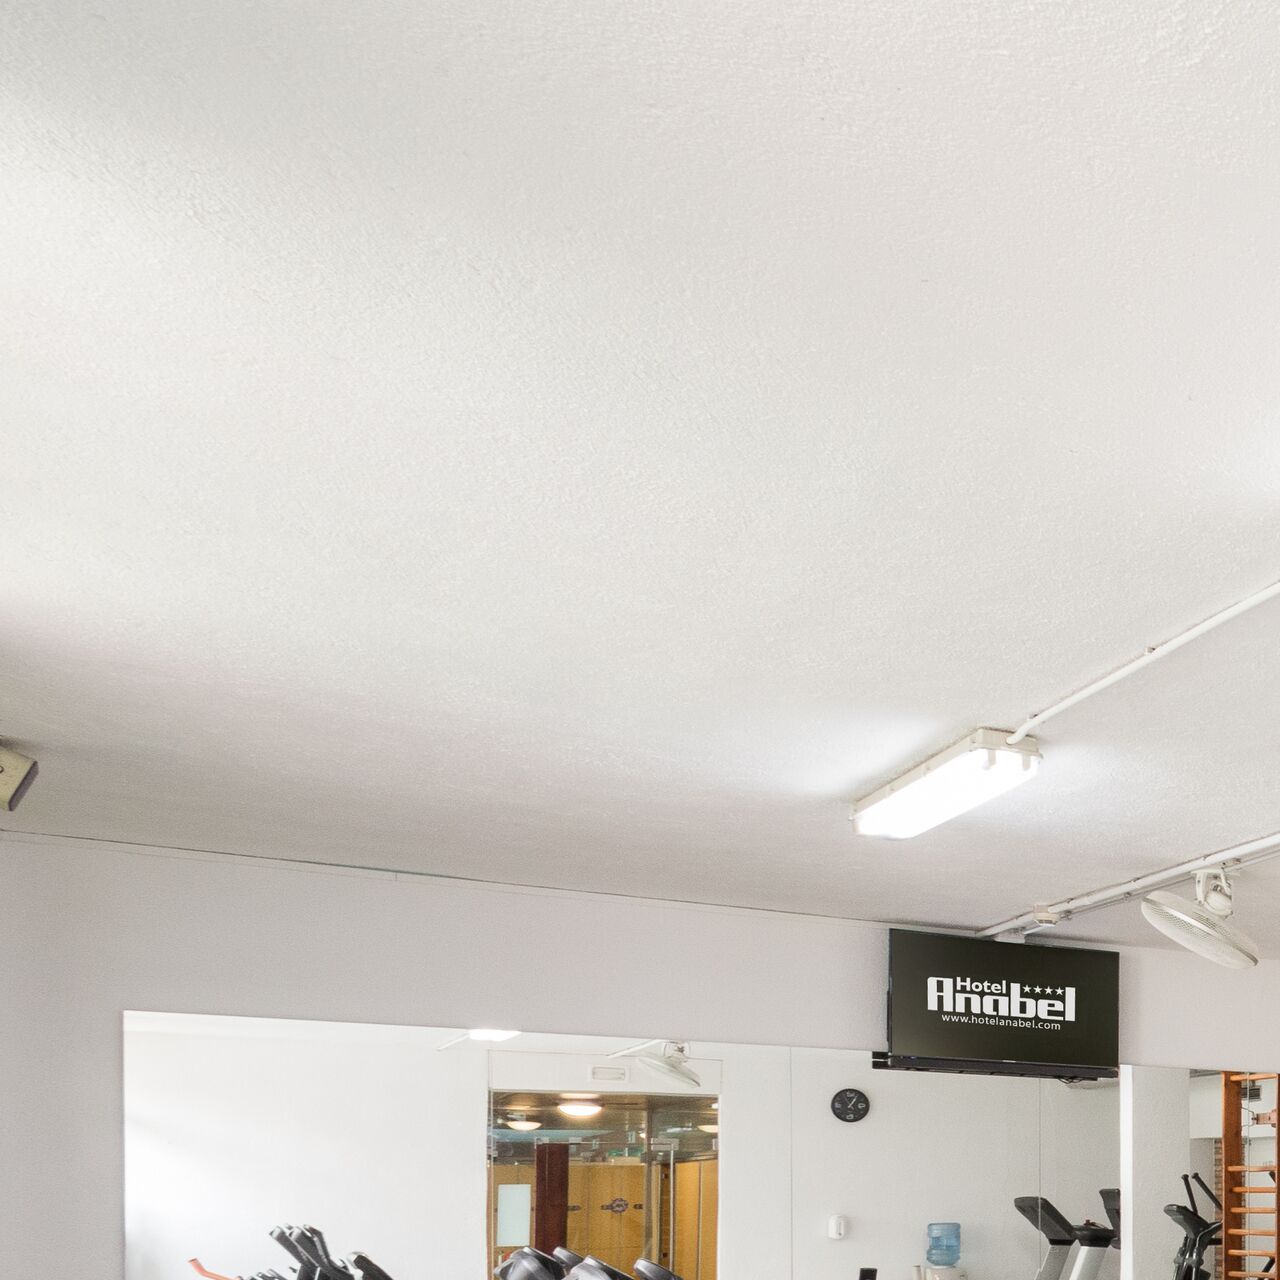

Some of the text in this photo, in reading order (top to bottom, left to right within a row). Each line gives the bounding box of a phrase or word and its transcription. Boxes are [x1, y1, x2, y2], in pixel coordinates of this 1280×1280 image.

[956, 976, 1007, 995] Hotel
[927, 976, 1076, 1022] Anabel
[941, 1013, 1062, 1031] www.hotelanabel.com
